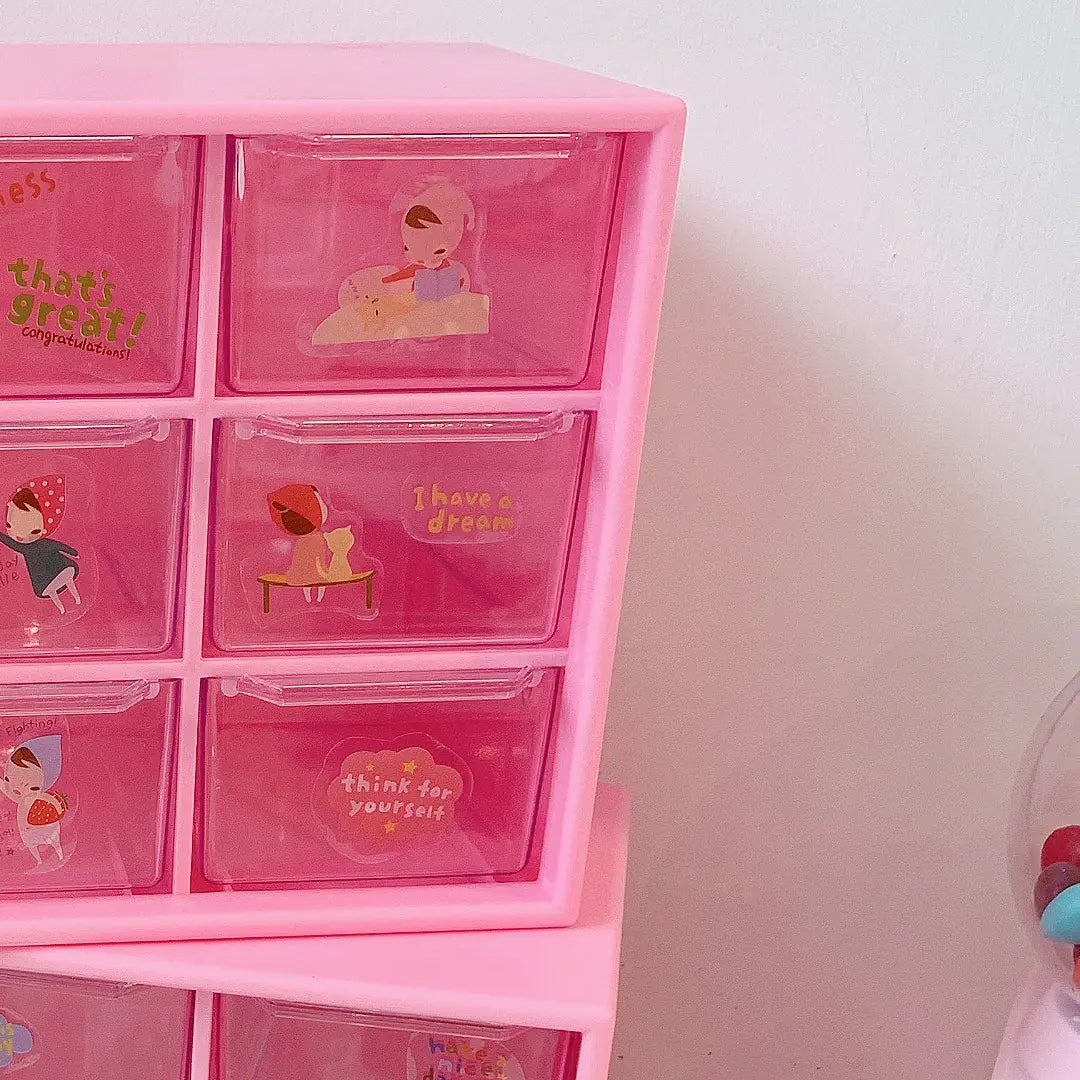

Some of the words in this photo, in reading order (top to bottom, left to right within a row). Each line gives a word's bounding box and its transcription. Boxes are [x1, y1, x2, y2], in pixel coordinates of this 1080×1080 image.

[8, 258, 116, 308] that's
[7, 293, 147, 349] great!
[21, 325, 131, 361] congratulations!
[414, 486, 424, 511] I
[431, 483, 491, 509] have
[499, 495, 512, 509] a
[427, 509, 514, 534] dream
[341, 773, 411, 793] think
[418, 779, 453, 800] for
[349, 800, 445, 821] yourself
